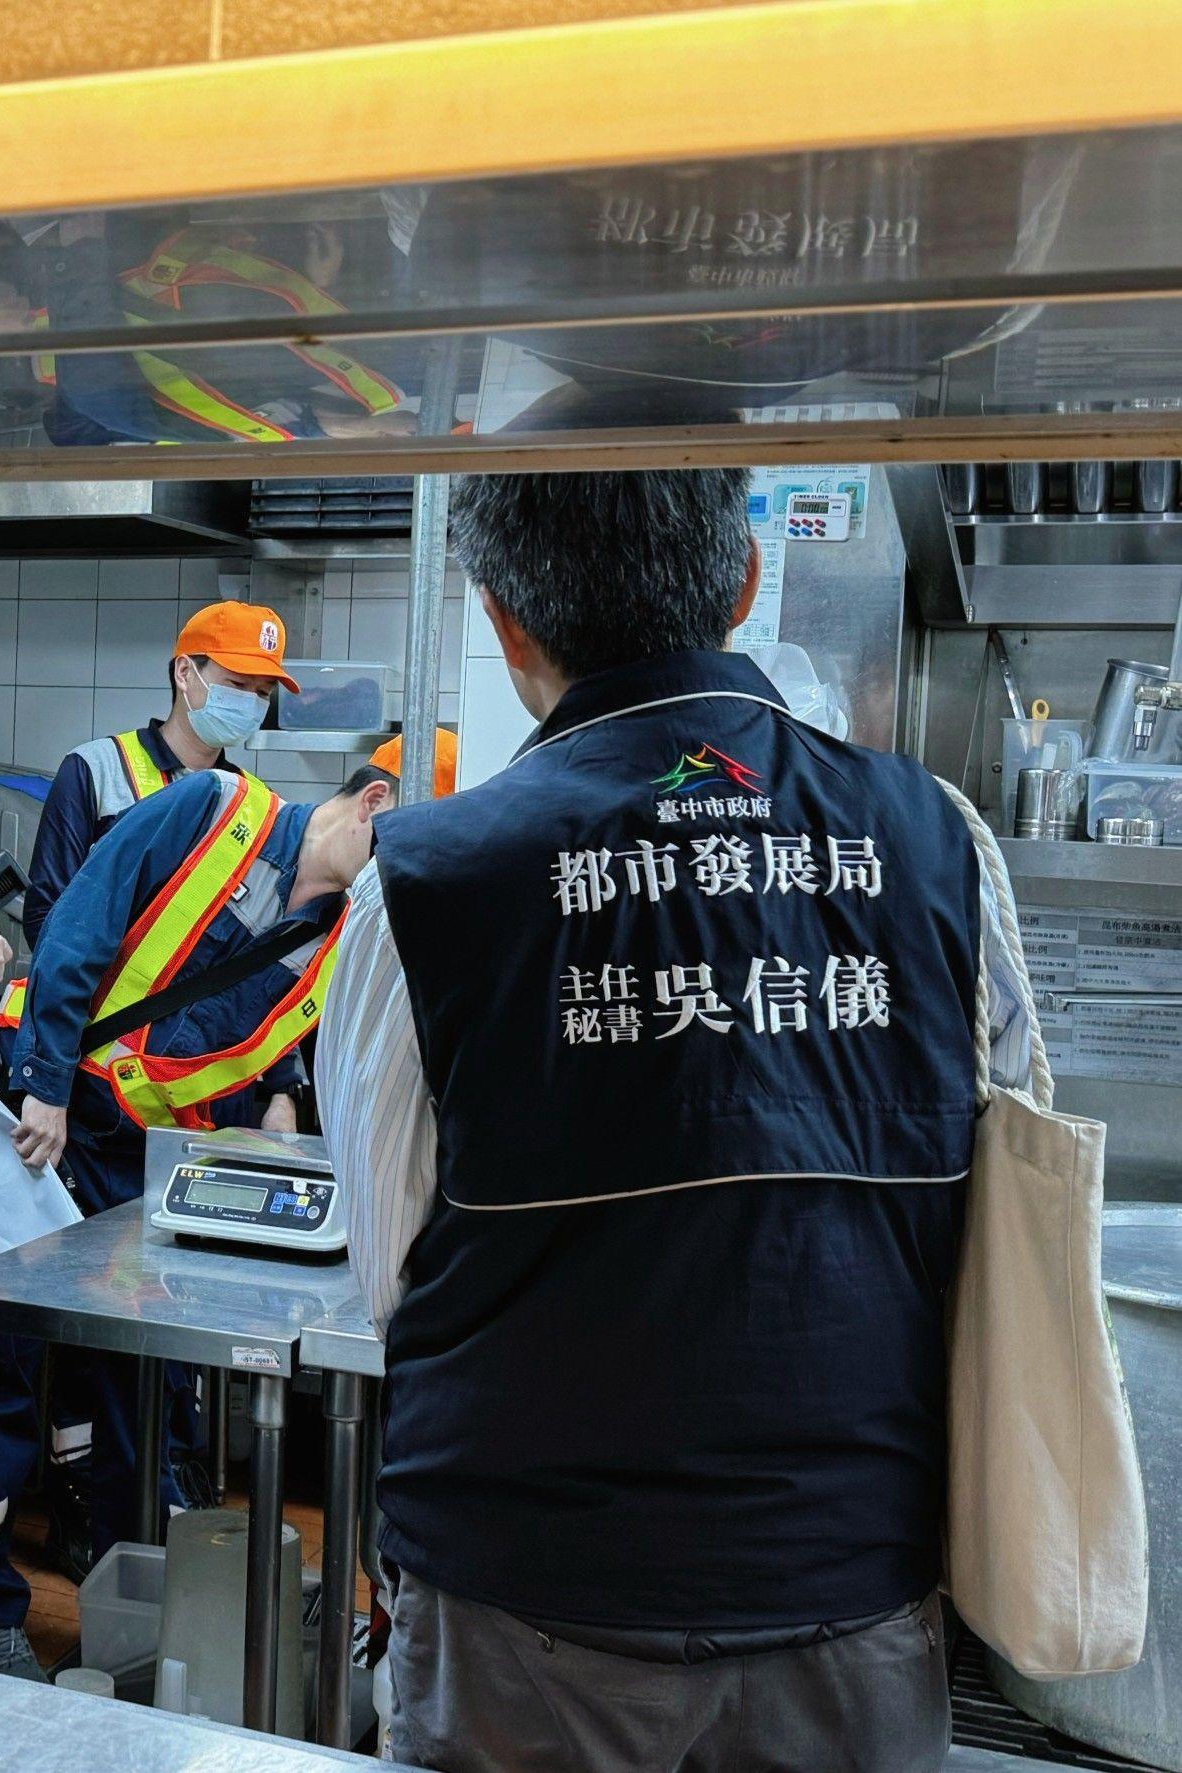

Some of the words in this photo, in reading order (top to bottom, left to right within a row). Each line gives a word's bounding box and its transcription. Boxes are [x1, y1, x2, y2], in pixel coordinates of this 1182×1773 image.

[656, 796, 772, 823] 臺中市政府
[550, 832, 883, 916] 都市發展局
[559, 963, 640, 1003] 主任
[653, 954, 892, 1040] 吳信儀
[561, 1004, 644, 1045] 秘書
